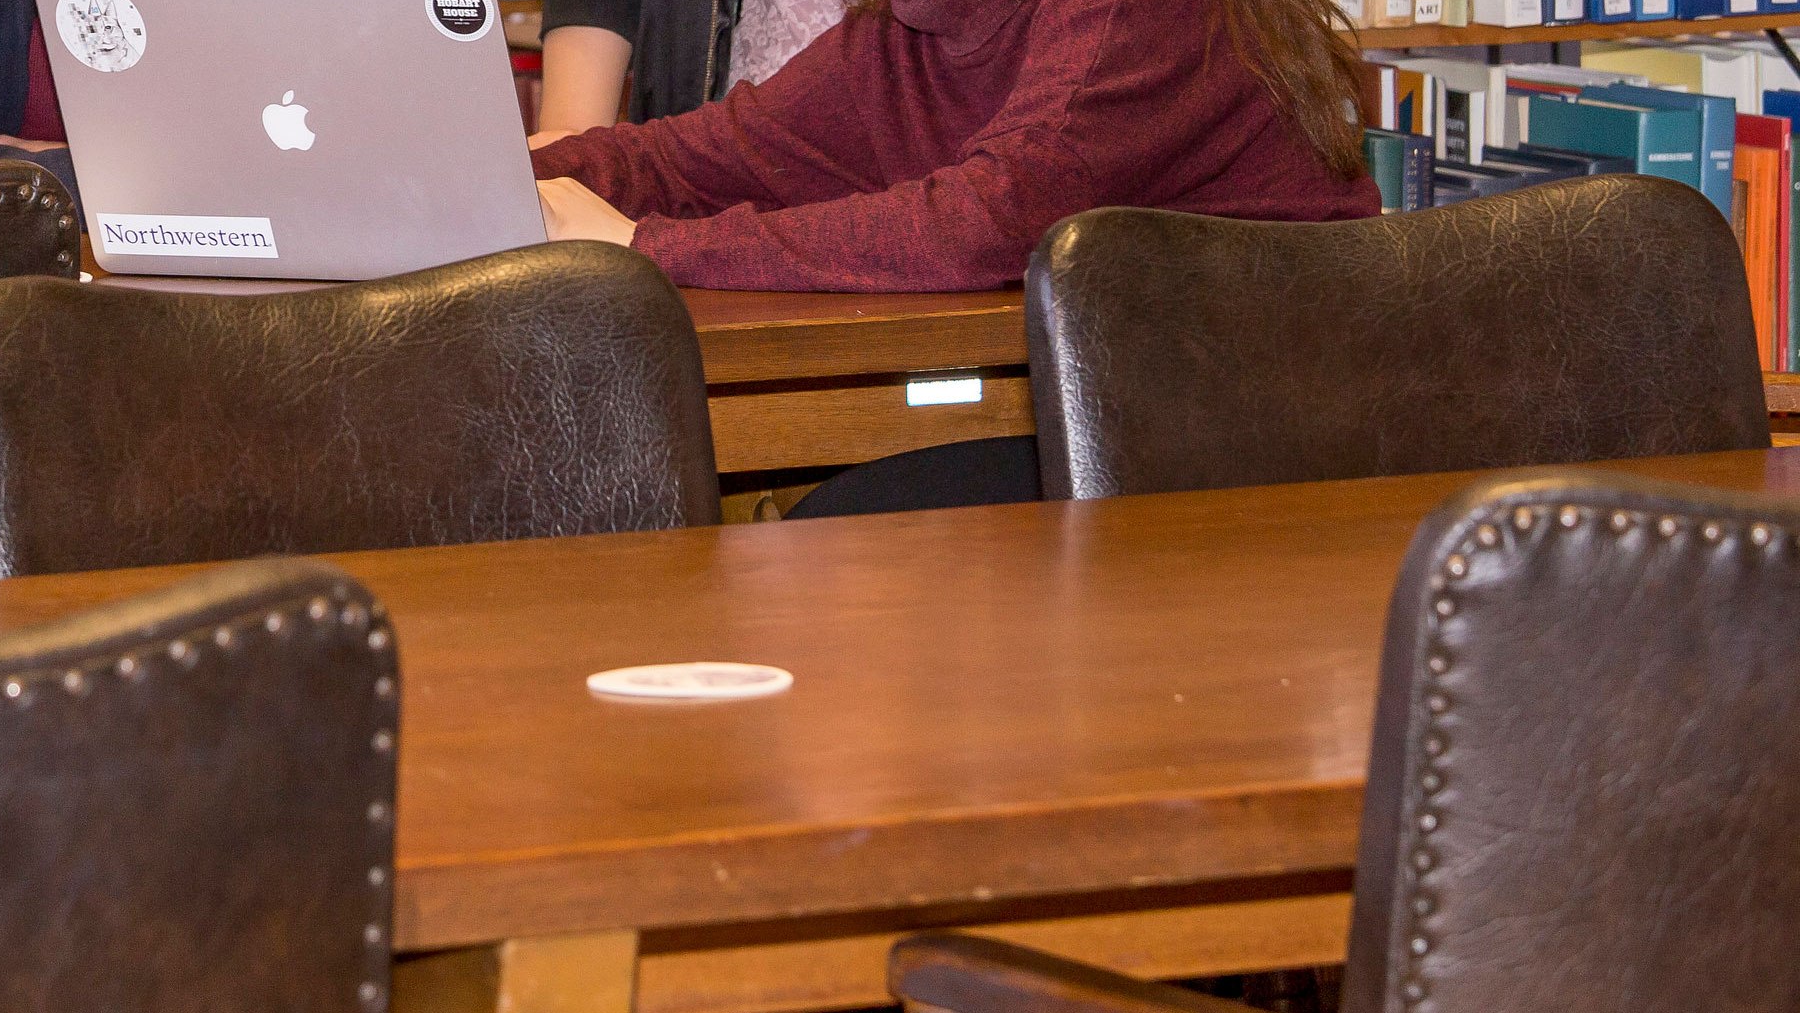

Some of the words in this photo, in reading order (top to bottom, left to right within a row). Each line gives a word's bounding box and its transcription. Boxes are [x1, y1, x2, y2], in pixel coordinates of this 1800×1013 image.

[437, 0, 480, 7] HOBART
[443, 9, 478, 17] HOUSE
[1417, 4, 1438, 15] ART
[104, 223, 270, 247] Northwestern
